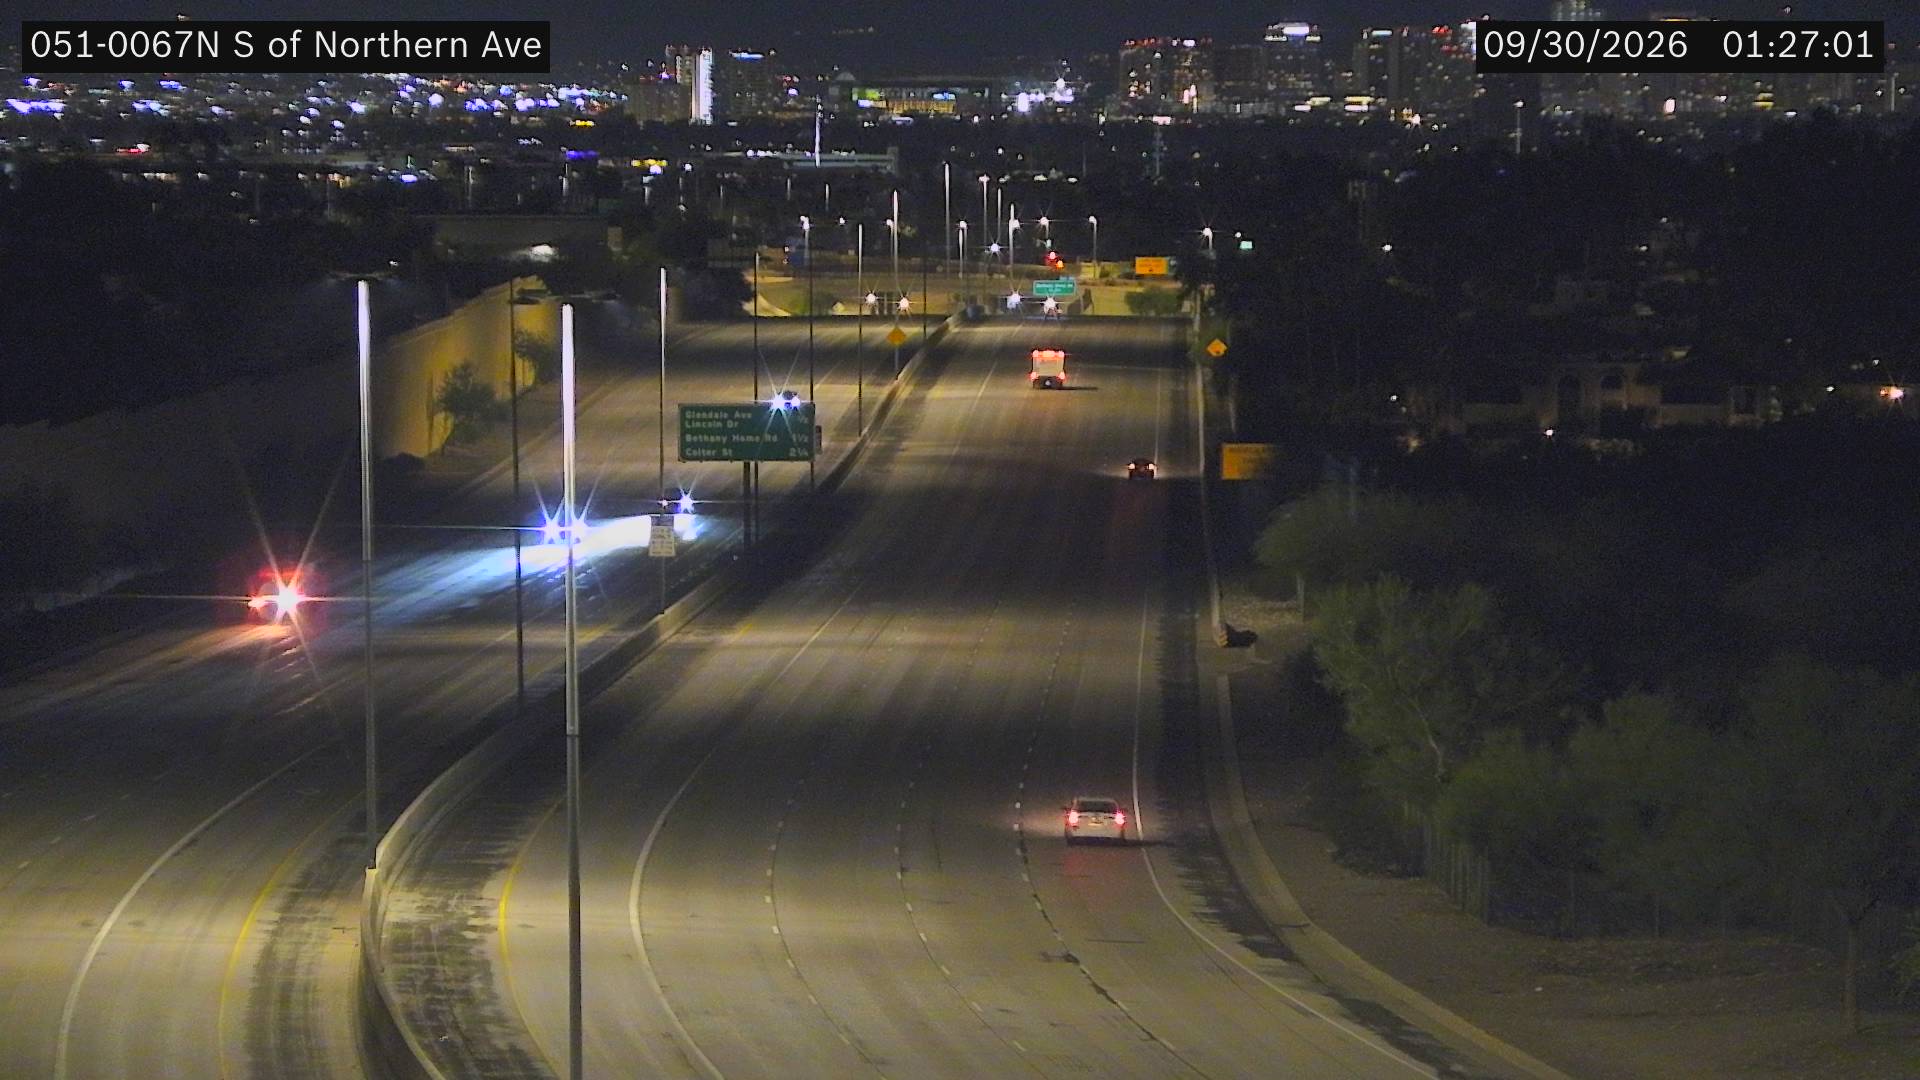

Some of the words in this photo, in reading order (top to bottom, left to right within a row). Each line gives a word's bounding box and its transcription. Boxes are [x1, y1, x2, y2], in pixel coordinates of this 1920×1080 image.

[685, 410, 729, 419] Glendale
[734, 410, 753, 419] Ave
[685, 420, 723, 428] Lincoln
[727, 420, 739, 428] Dr
[685, 434, 728, 444] Bethany
[732, 434, 760, 442] Home
[765, 434, 778, 442] Rd
[685, 448, 717, 456] Colter
[722, 448, 733, 456] St
